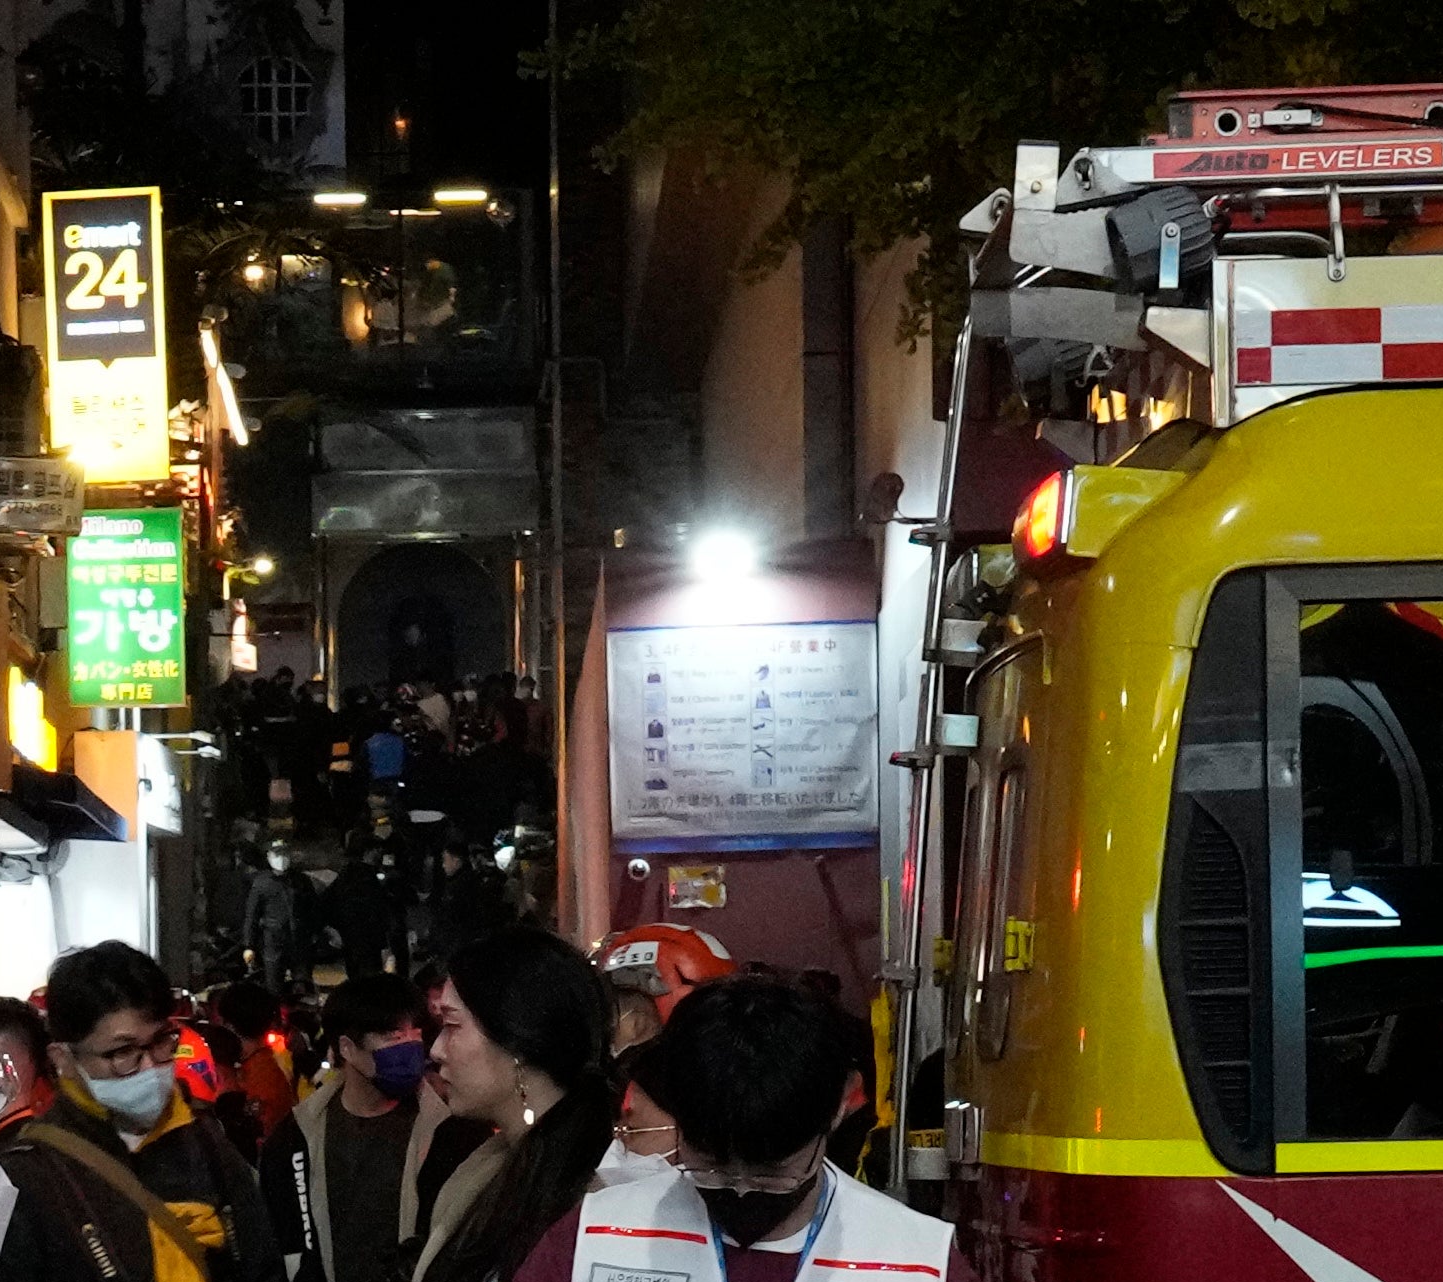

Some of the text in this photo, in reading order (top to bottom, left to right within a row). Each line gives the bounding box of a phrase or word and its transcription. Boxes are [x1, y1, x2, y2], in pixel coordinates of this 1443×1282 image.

[1281, 146, 1434, 171] LEVELERS
[64, 248, 147, 310] 24
[73, 608, 179, 653] 가방
